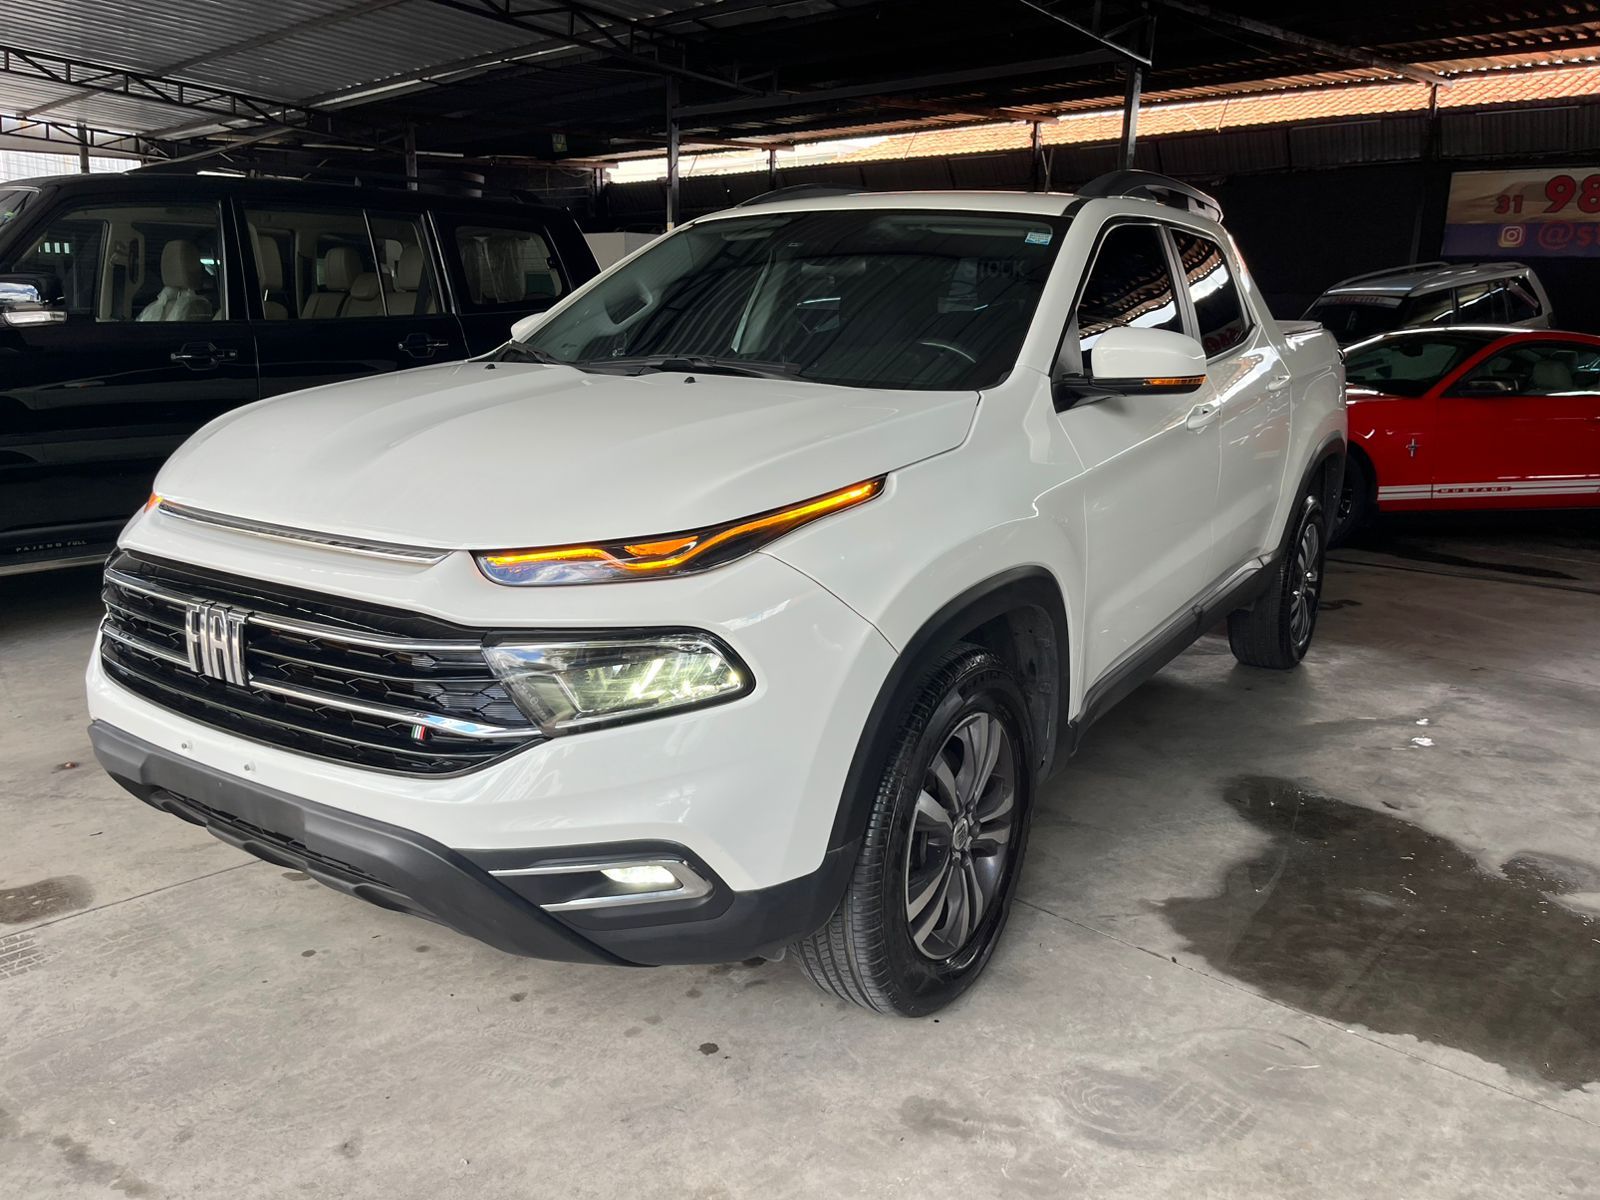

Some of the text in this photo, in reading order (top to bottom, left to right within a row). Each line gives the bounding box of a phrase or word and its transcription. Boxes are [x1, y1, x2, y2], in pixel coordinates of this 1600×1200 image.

[1495, 194, 1524, 214] 31
[15, 542, 62, 553] PAJERO
[185, 603, 247, 687] FIAT
